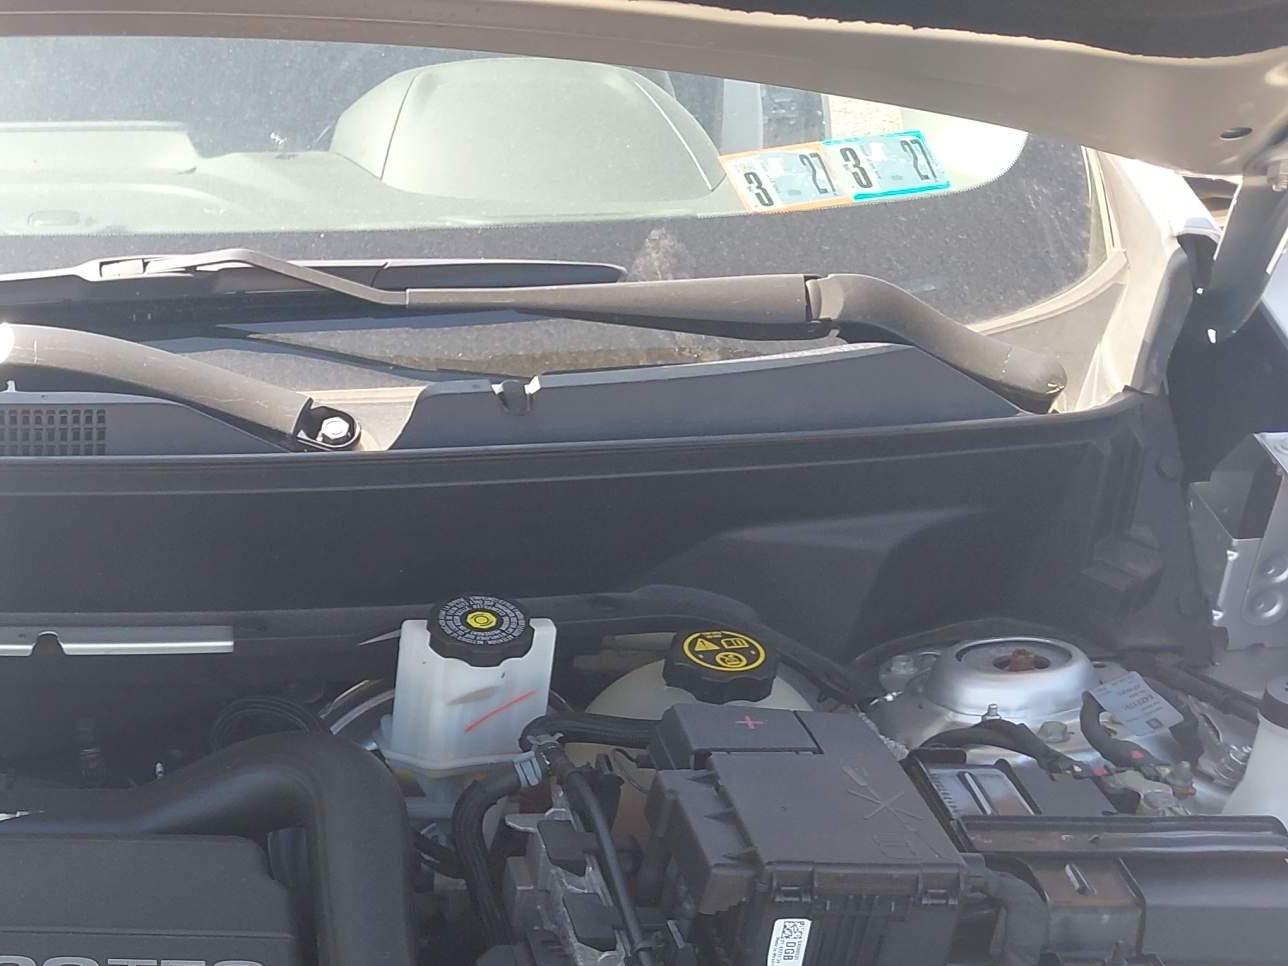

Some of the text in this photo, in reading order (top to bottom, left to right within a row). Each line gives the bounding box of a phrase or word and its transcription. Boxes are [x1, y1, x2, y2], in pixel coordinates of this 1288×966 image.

[744, 152, 837, 207] 3 27
[839, 138, 937, 189] 3 27
